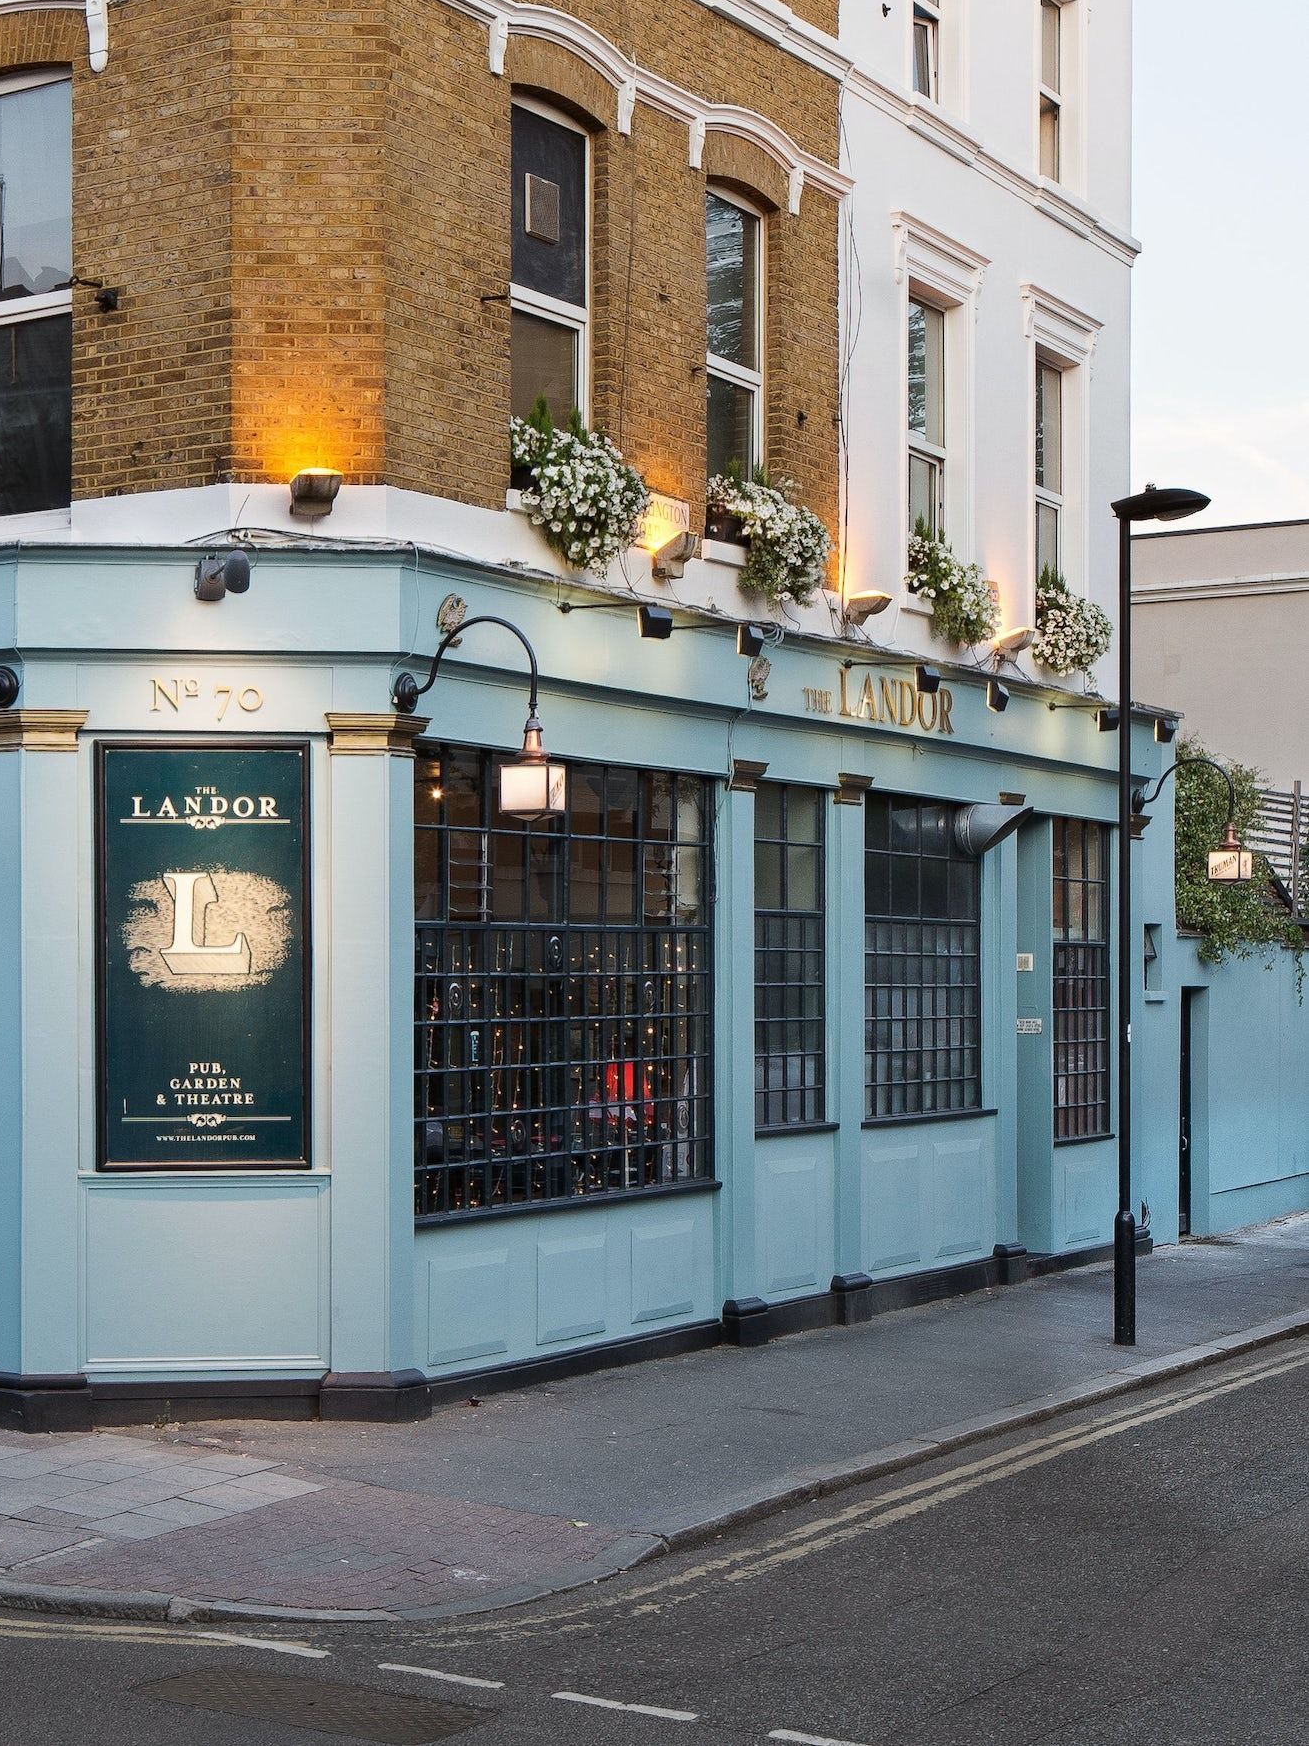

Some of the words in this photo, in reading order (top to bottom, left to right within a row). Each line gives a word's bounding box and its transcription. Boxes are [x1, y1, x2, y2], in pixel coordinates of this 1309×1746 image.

[214, 683, 264, 722] 70
[803, 687, 833, 713] THE
[839, 668, 954, 735] LANDOR
[194, 786, 217, 795] THE
[131, 796, 279, 818] LANDOR
[1211, 855, 1237, 876] TRUMAN
[159, 872, 248, 964] L
[189, 1062, 227, 1075] PUB,
[170, 1078, 242, 1090] GARDEN
[156, 1093, 167, 1105] &
[174, 1093, 255, 1105] THEATRE
